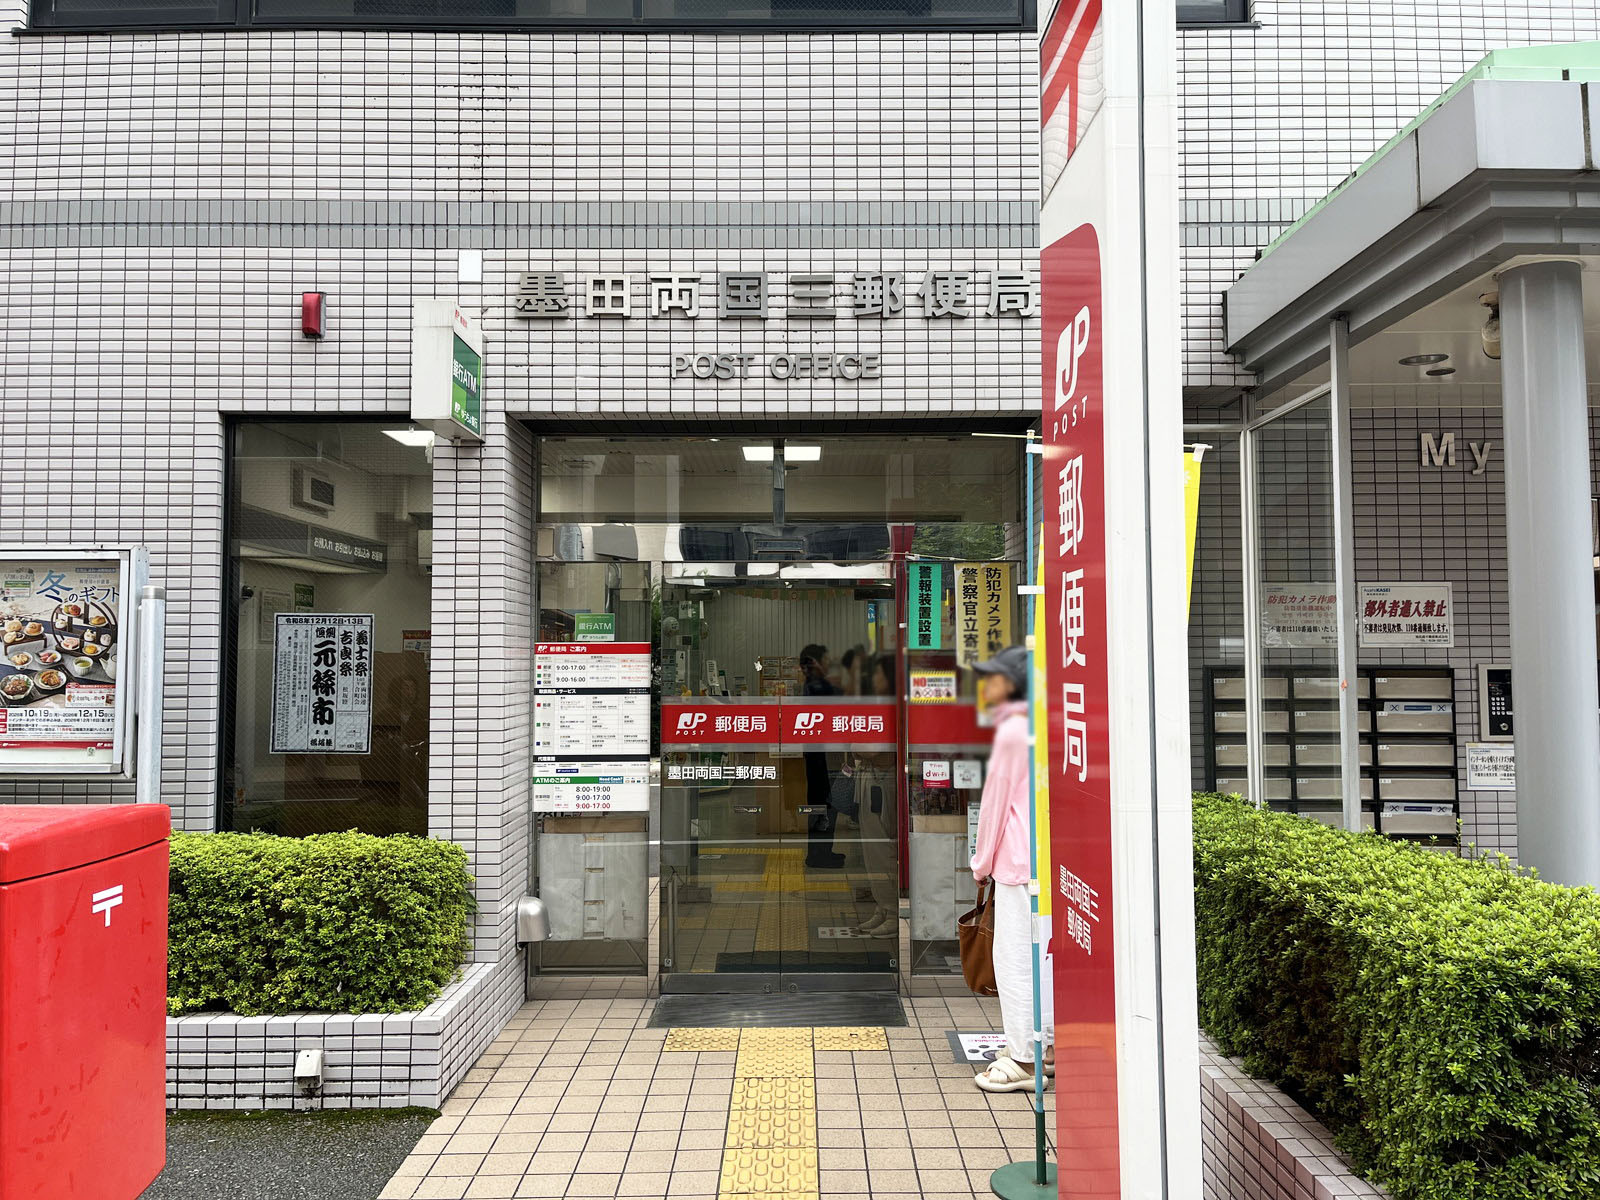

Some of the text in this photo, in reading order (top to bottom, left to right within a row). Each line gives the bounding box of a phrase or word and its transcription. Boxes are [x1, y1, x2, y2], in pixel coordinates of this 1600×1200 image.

[515, 270, 1038, 319] 墨田両国三郵便局
[670, 353, 881, 380] POST OFFICE
[1055, 304, 1090, 414] JP
[1053, 396, 1090, 442] POST
[1420, 432, 1492, 475] My
[578, 622, 612, 630] 銀行ATM
[918, 565, 932, 647] 警報装置設置
[961, 567, 979, 665] 警察官立寄所
[1057, 453, 1089, 784] 郵便局
[1364, 600, 1447, 618] 部外者進入禁止
[312, 640, 336, 725] 元禄市
[913, 678, 927, 687] NO
[677, 712, 767, 733] JP 郵便局
[794, 712, 884, 733] JP 郵便局
[668, 766, 776, 780] 墨田両国三郵便局
[1060, 864, 1100, 922] 墨田両国三
[1067, 906, 1091, 955] 郵便局
